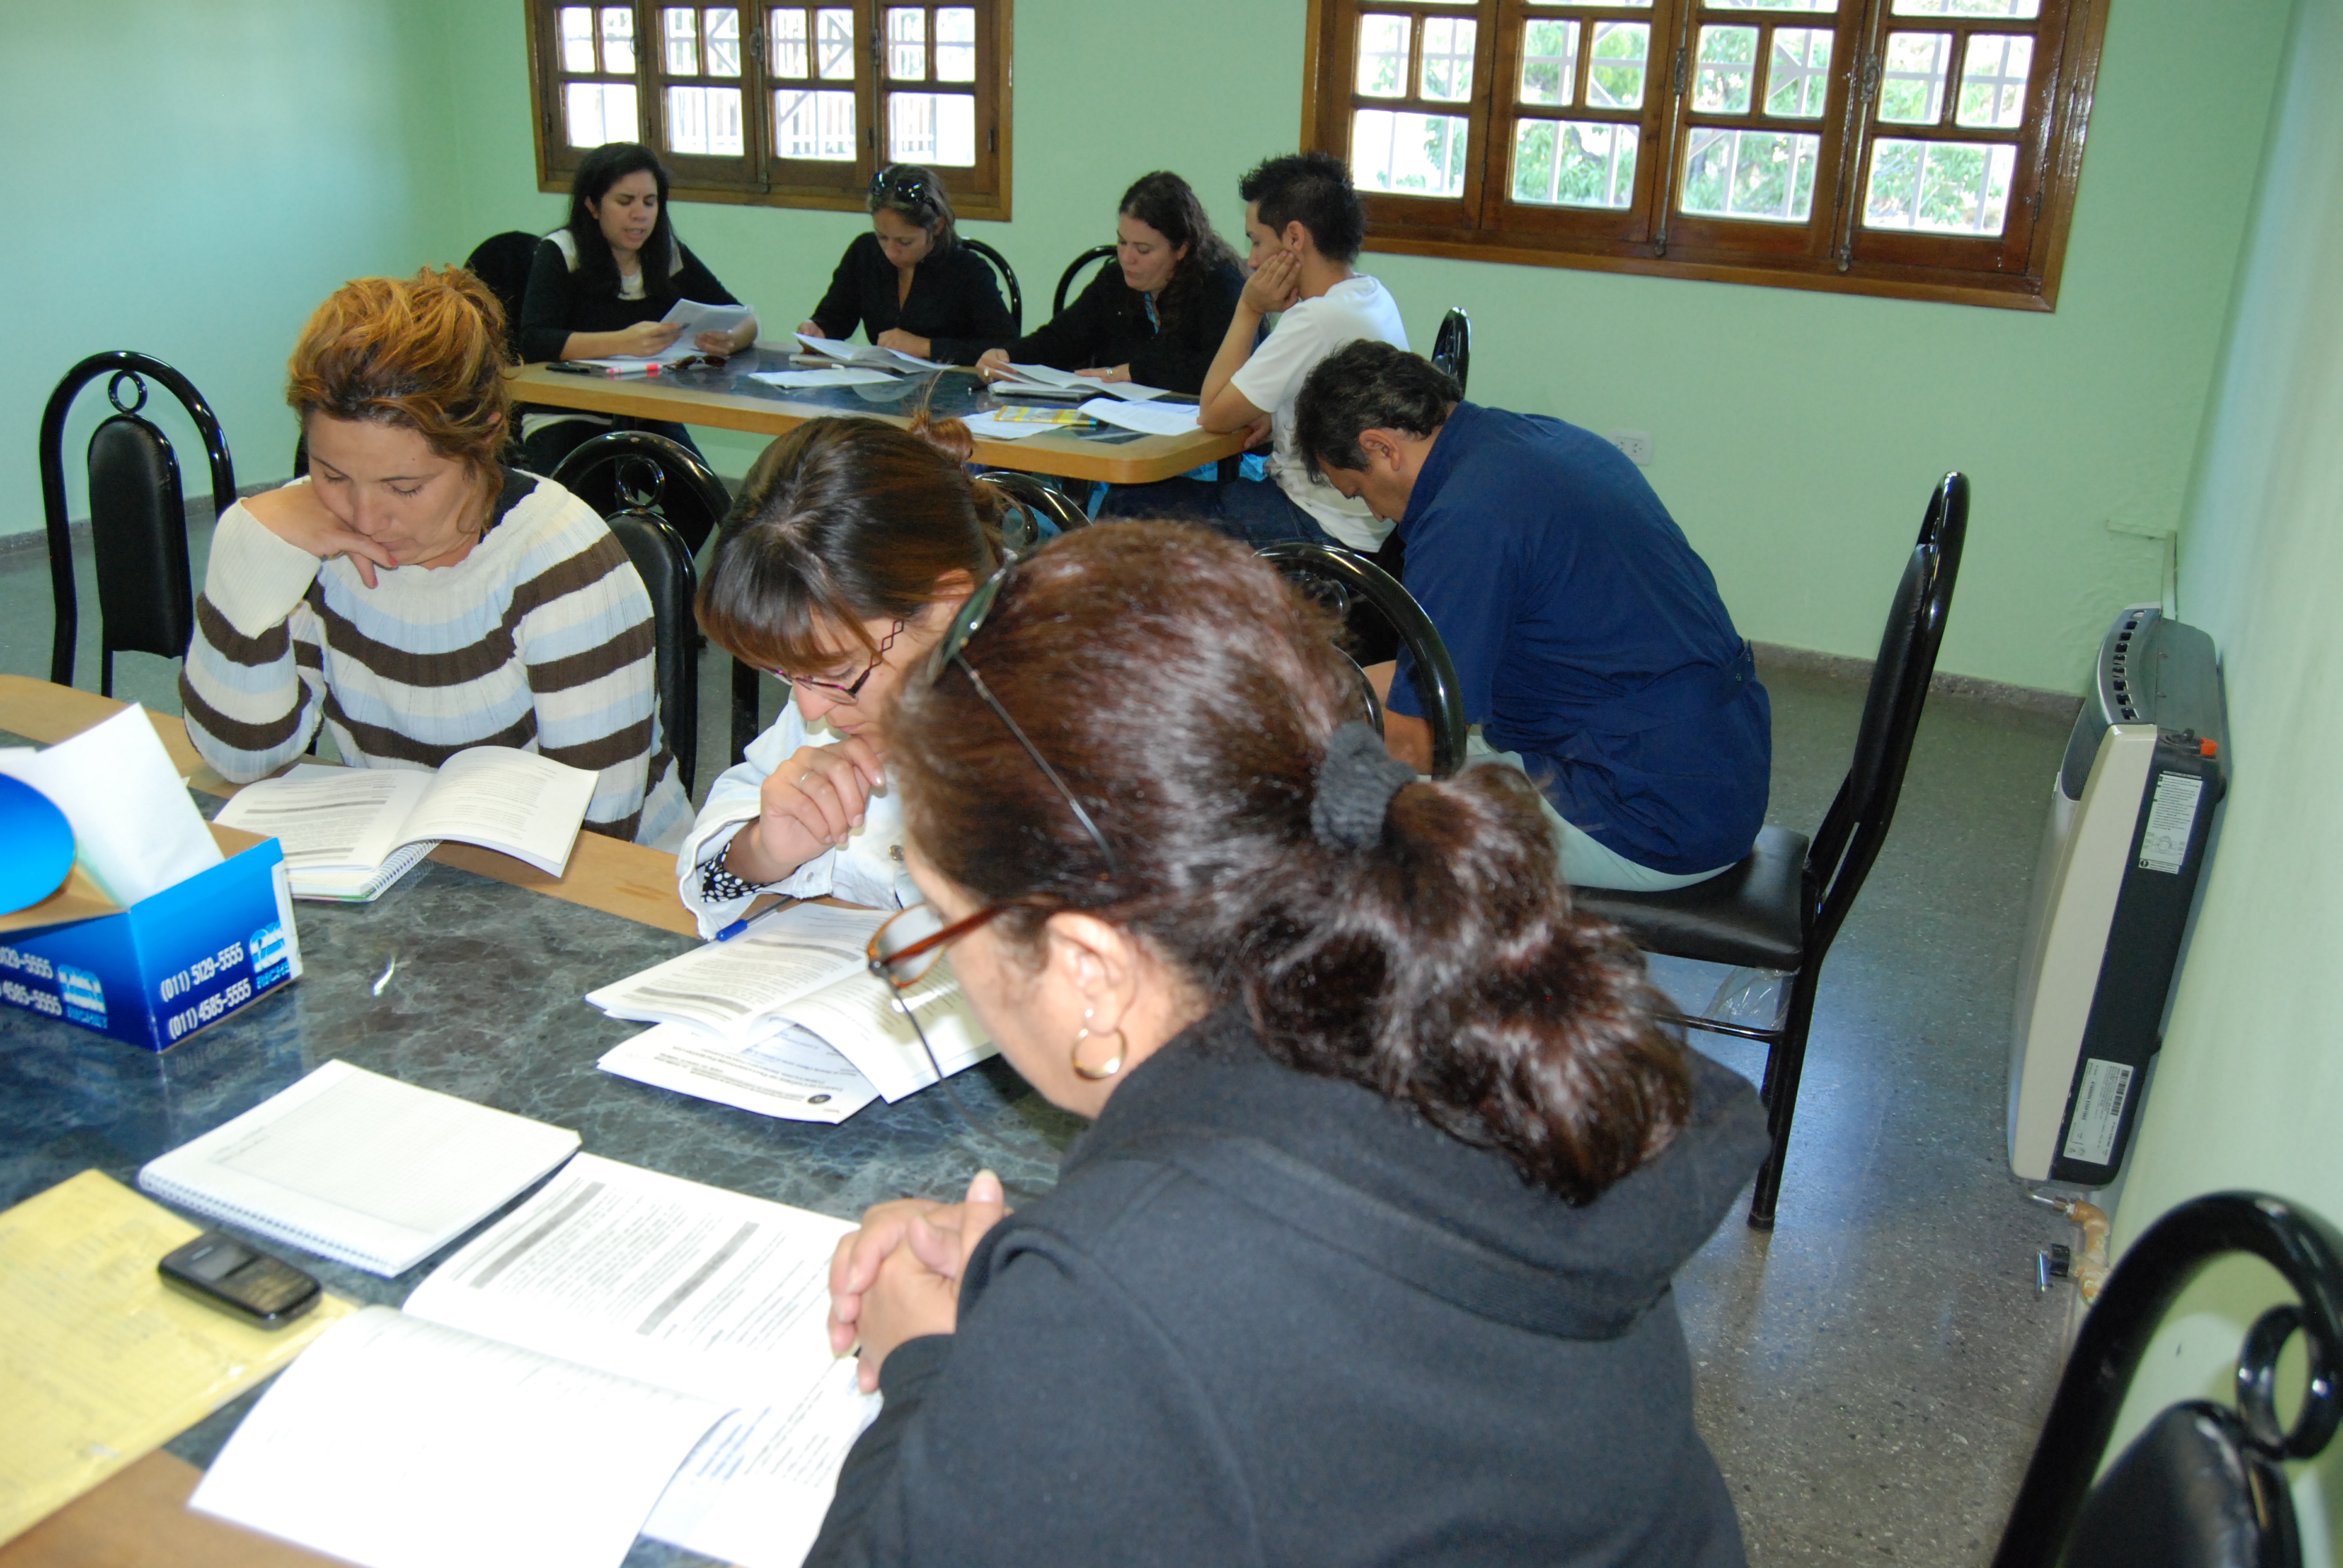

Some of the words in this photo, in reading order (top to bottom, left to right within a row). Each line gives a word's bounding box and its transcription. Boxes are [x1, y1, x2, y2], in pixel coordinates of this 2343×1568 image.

[0, 946, 53, 979] 129-5555
[160, 970, 191, 1002] (011)
[191, 941, 244, 985] 5129-5555
[3, 979, 62, 1016] 4585-5555
[169, 1007, 198, 1040] (011)
[198, 978, 251, 1022] 4585-5555
